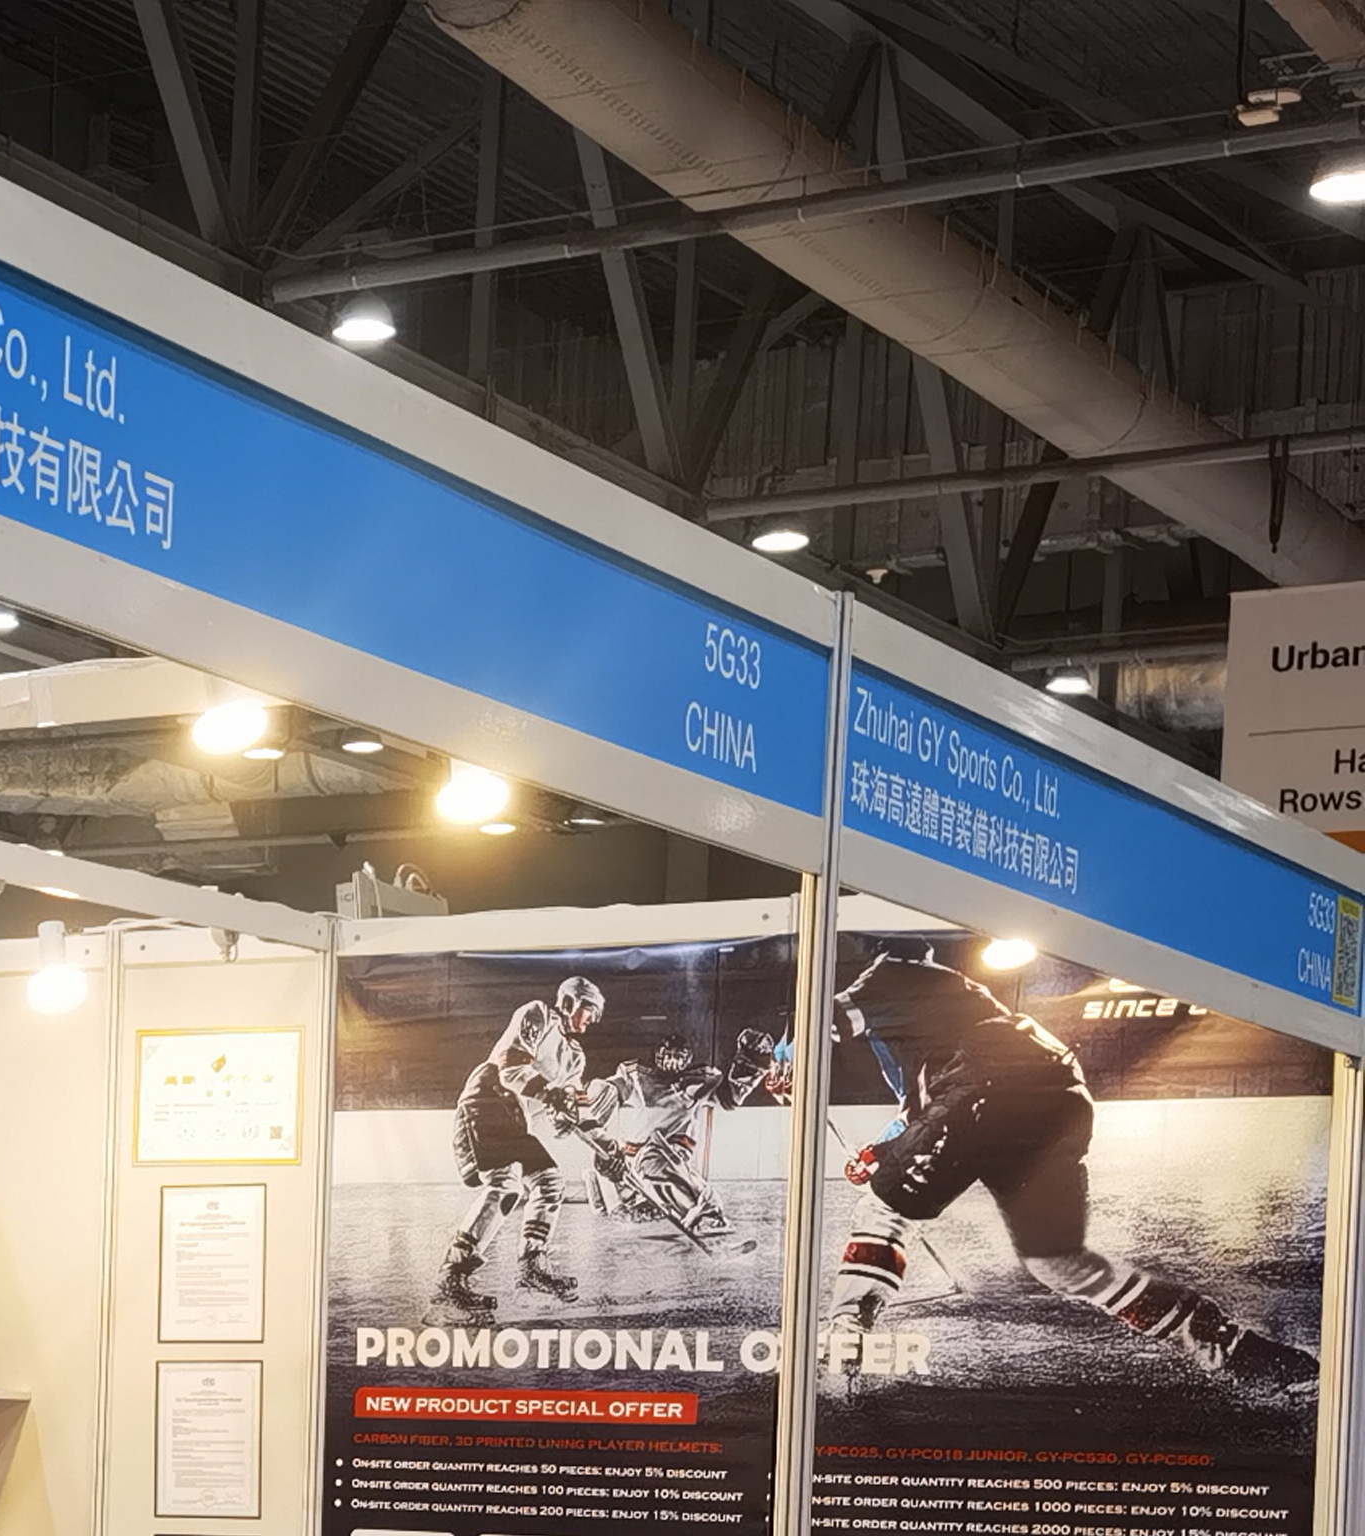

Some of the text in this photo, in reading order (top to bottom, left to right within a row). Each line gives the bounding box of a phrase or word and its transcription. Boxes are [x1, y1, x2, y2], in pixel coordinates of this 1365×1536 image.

[62, 335, 127, 425] Ltd.
[704, 621, 762, 691] 5G33
[685, 700, 758, 774] CHINA
[853, 687, 1062, 820] Zhuhai GY Sports Co., Ltd.
[1278, 787, 1362, 814] Rows
[850, 758, 1079, 895] 珠海高遠體育裝備科技有限公司
[1307, 891, 1337, 935] 5G33
[1297, 947, 1333, 993] CHINA
[356, 1326, 725, 1373] PROMOTIONAL
[366, 1395, 684, 1420] NEW PRODUCT SPECIAL OFFER
[353, 1433, 408, 1445] CARBON
[455, 1436, 473, 1447] 3D
[475, 1437, 534, 1449] PRINTED
[537, 1438, 586, 1450] LINING
[588, 1439, 646, 1451] PLAYER
[814, 1446, 883, 1459] Y-PC025,
[393, 1460, 430, 1471] ORDER
[432, 1461, 485, 1473] QUANTITY
[486, 1463, 538, 1474] REACHES
[540, 1464, 557, 1475] 50
[605, 1466, 642, 1478] ENJOY
[645, 1466, 664, 1478] 5%
[666, 1469, 728, 1480] DISCOUNT
[812, 1474, 1270, 1496] N-SITE ORDER QUANTITY REACHES 500 PIECES: ENJOY 5% DISCOUNT
